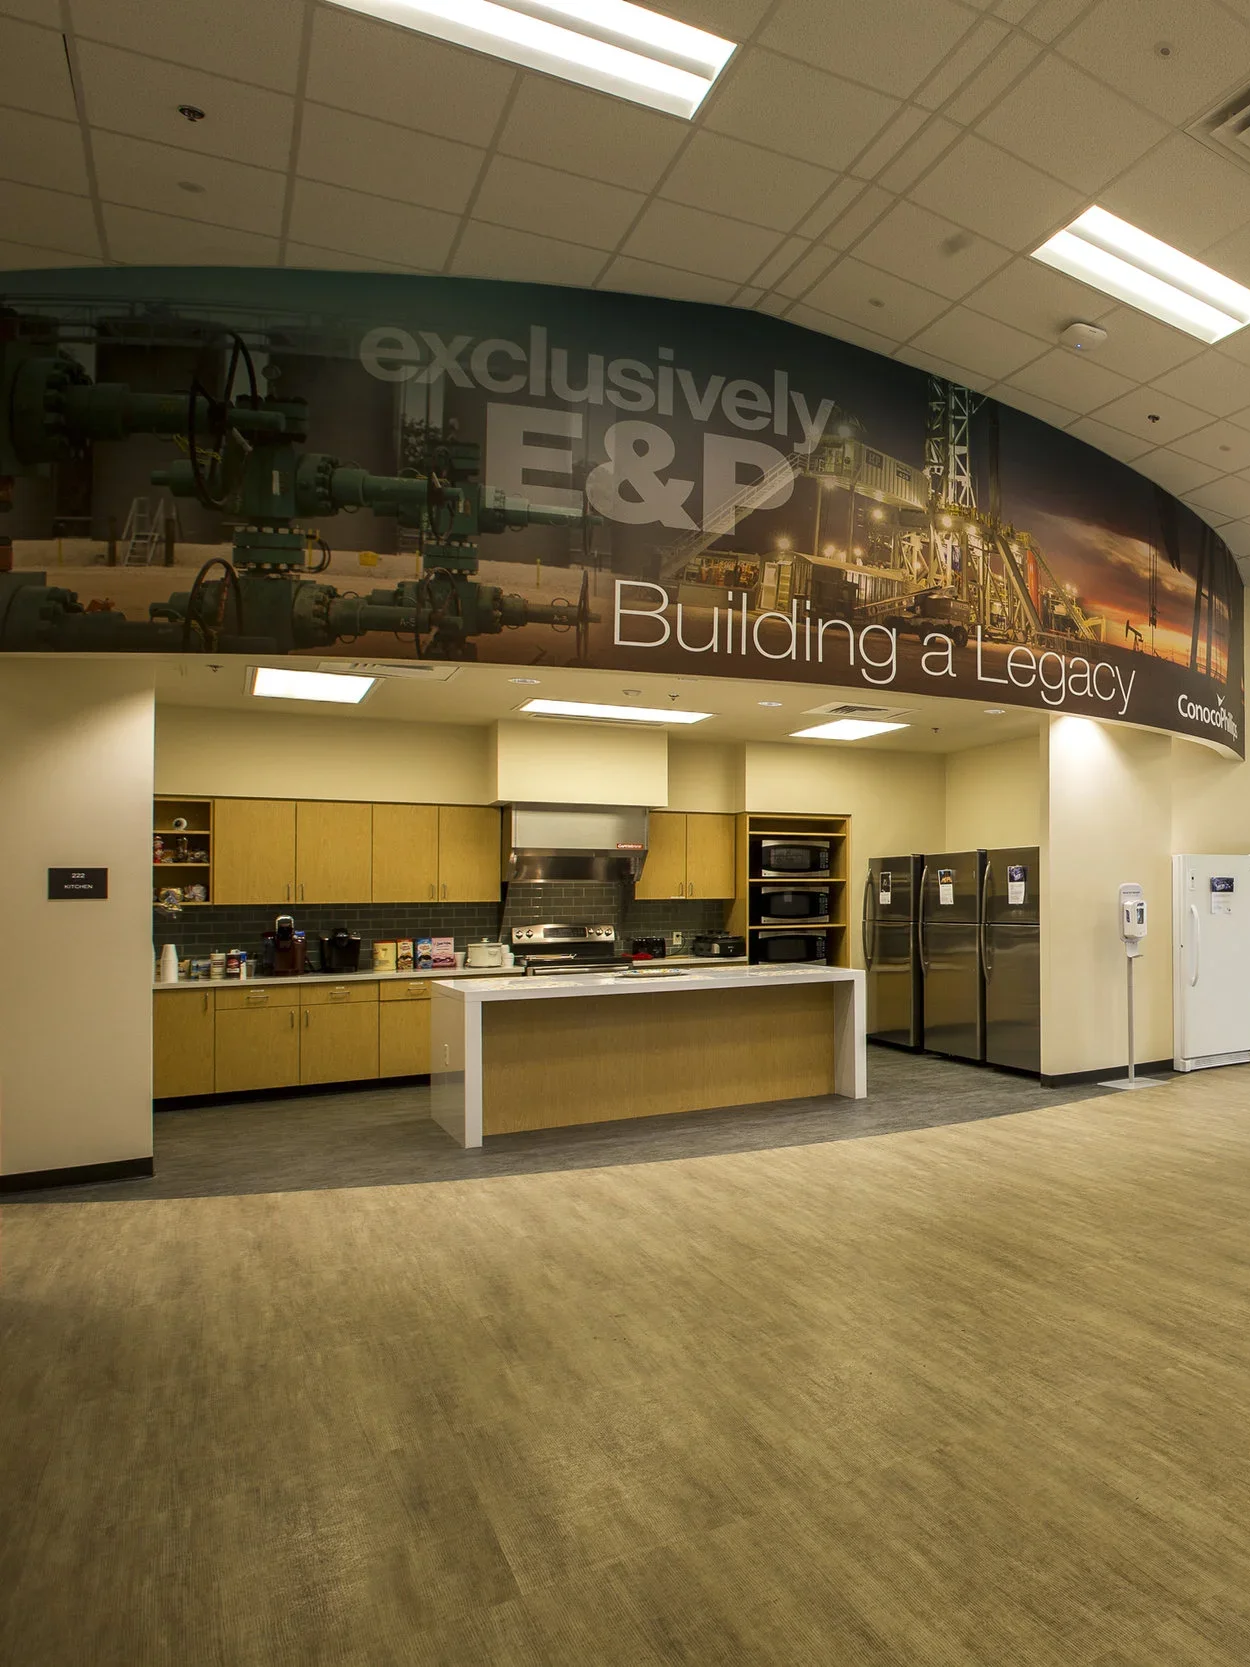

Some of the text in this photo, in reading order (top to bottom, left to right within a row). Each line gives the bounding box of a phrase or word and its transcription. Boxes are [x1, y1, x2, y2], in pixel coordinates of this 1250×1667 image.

[359, 325, 836, 454] exclusively
[485, 402, 795, 536] E&P
[613, 579, 1136, 715] Building a Legacy
